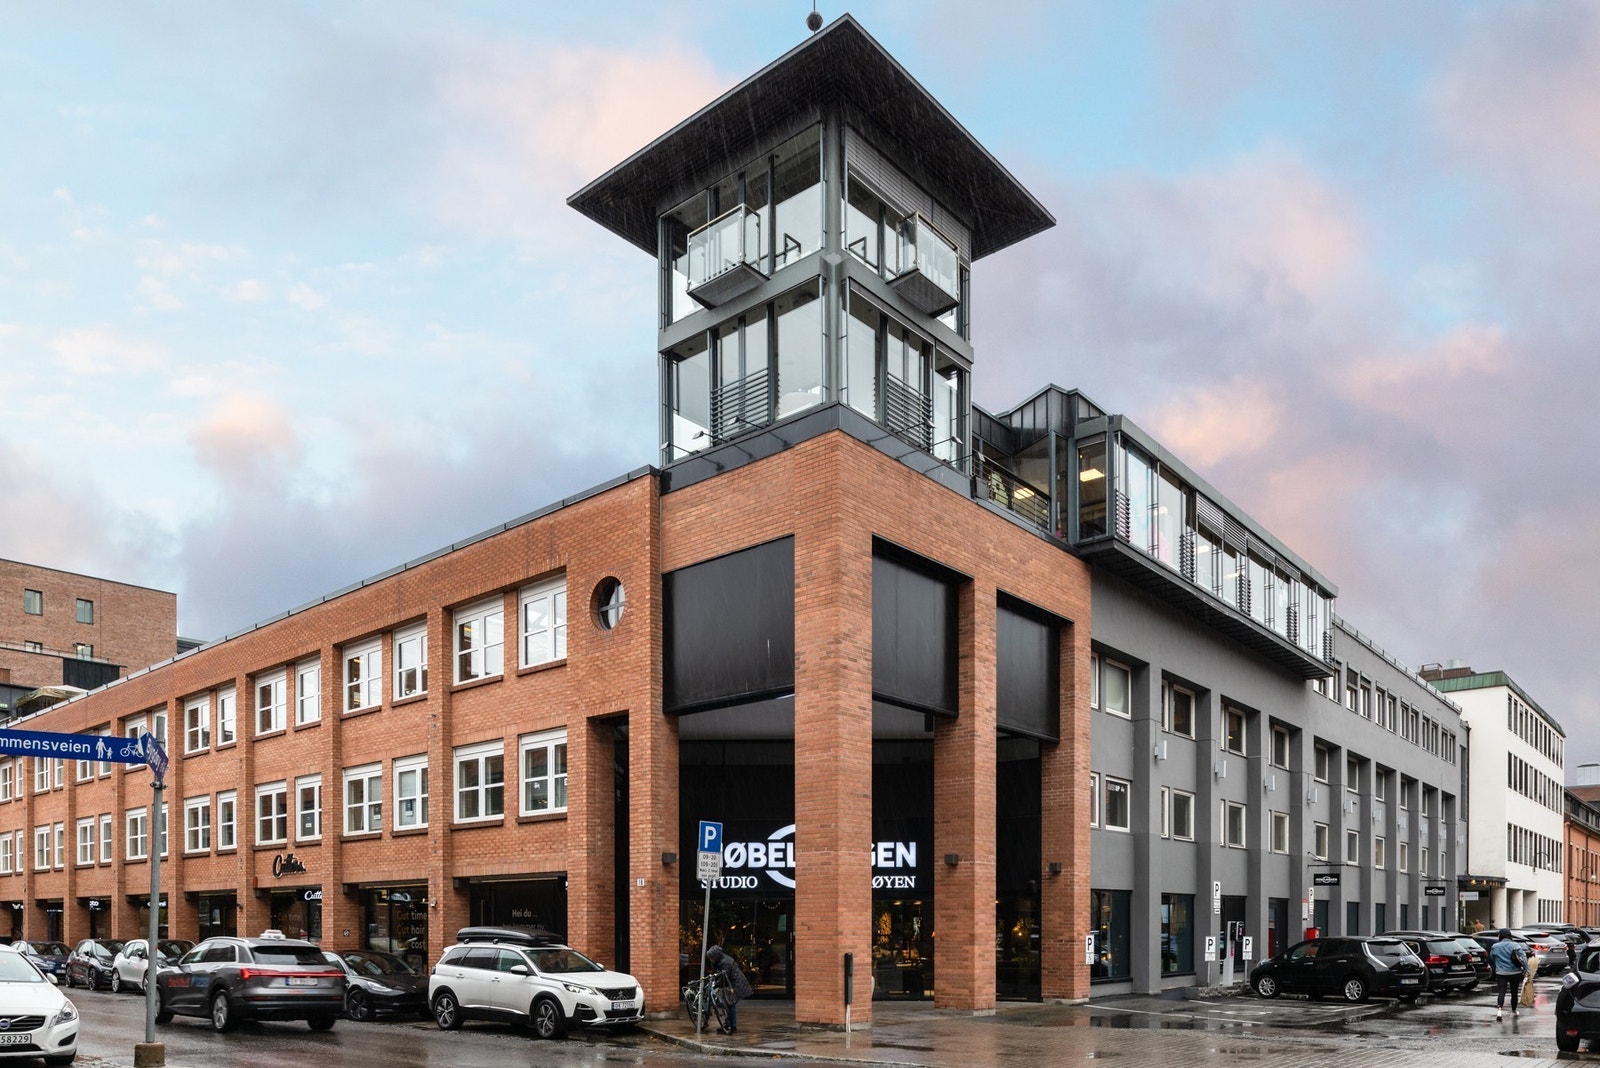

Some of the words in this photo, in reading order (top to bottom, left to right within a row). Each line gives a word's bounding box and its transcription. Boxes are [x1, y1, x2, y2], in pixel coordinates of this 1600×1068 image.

[704, 826, 717, 849] P
[411, 910, 428, 920] time
[411, 924, 425, 935] hair
[1087, 937, 1093, 951] P
[1208, 939, 1214, 951] P
[1245, 939, 1251, 951] P
[1, 1035, 29, 1044] 58229
